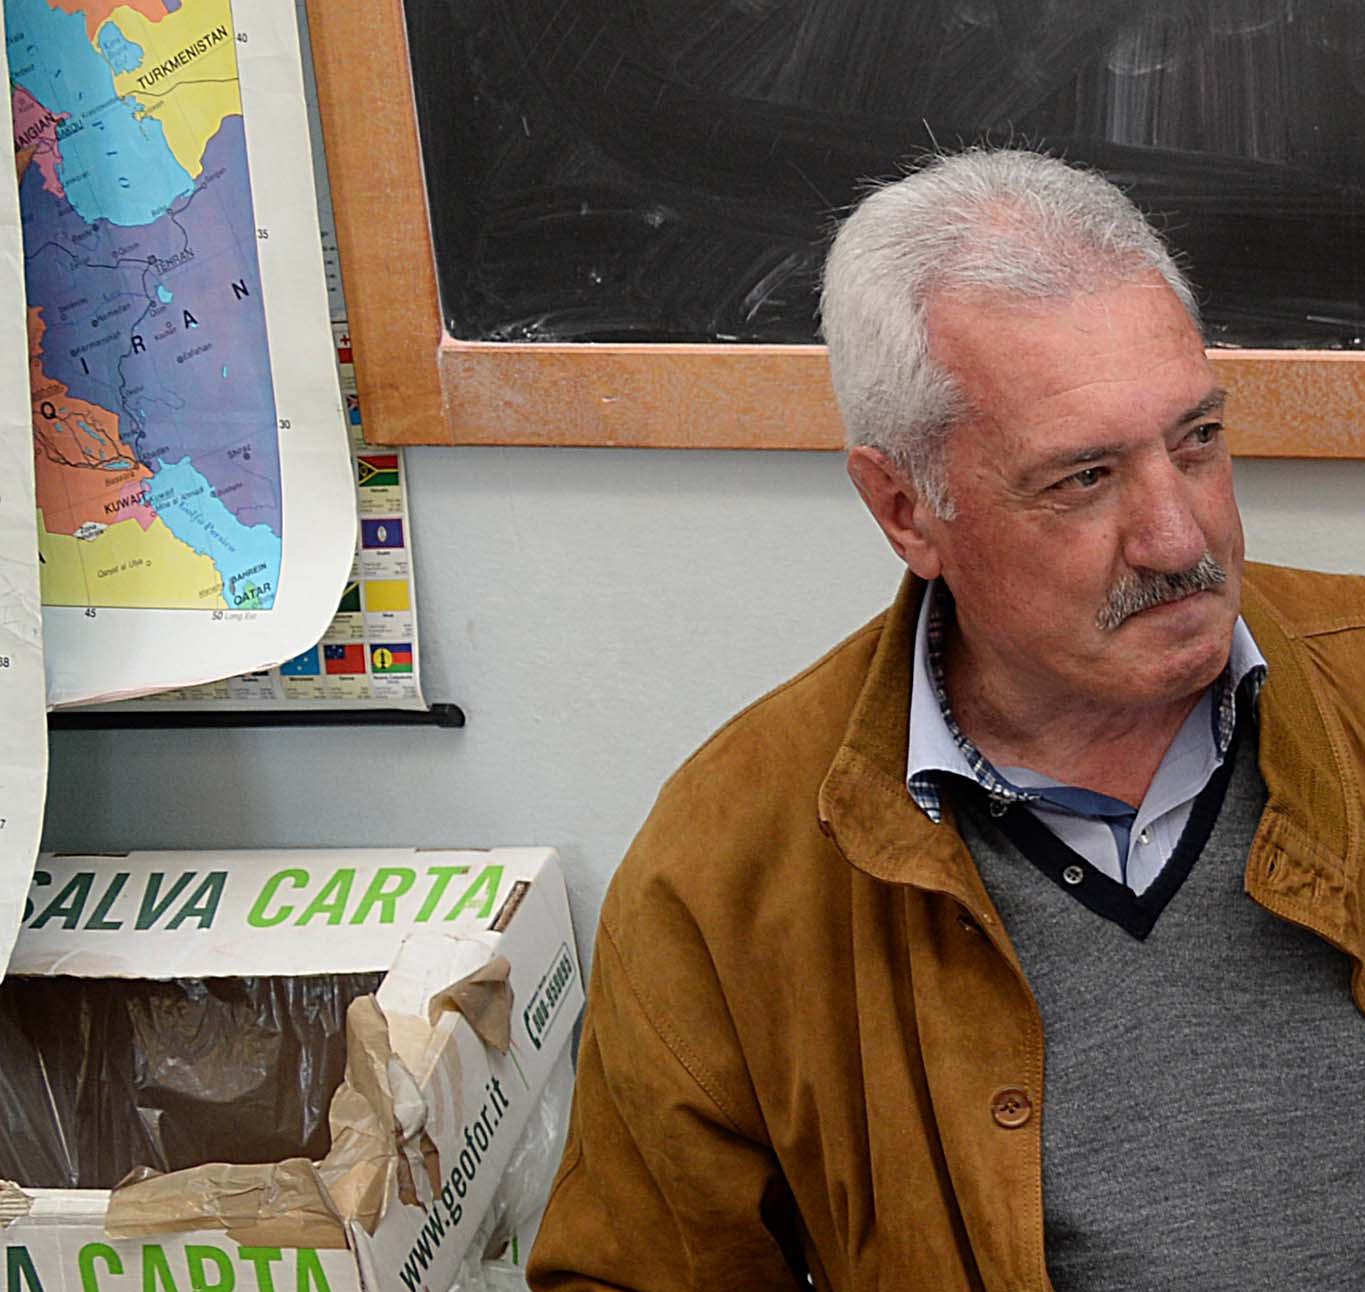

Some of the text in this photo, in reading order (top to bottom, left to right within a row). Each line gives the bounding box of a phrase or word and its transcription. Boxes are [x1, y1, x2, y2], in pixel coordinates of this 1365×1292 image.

[237, 33, 247, 42] 40
[136, 25, 228, 90] TURKMENISTAN
[257, 229, 269, 239] 35
[279, 419, 291, 429] 30
[104, 490, 147, 514] KUWAIT
[234, 582, 272, 606] QATAR
[85, 607, 97, 618] 45
[211, 611, 223, 620] 50
[247, 866, 505, 928] CARTA
